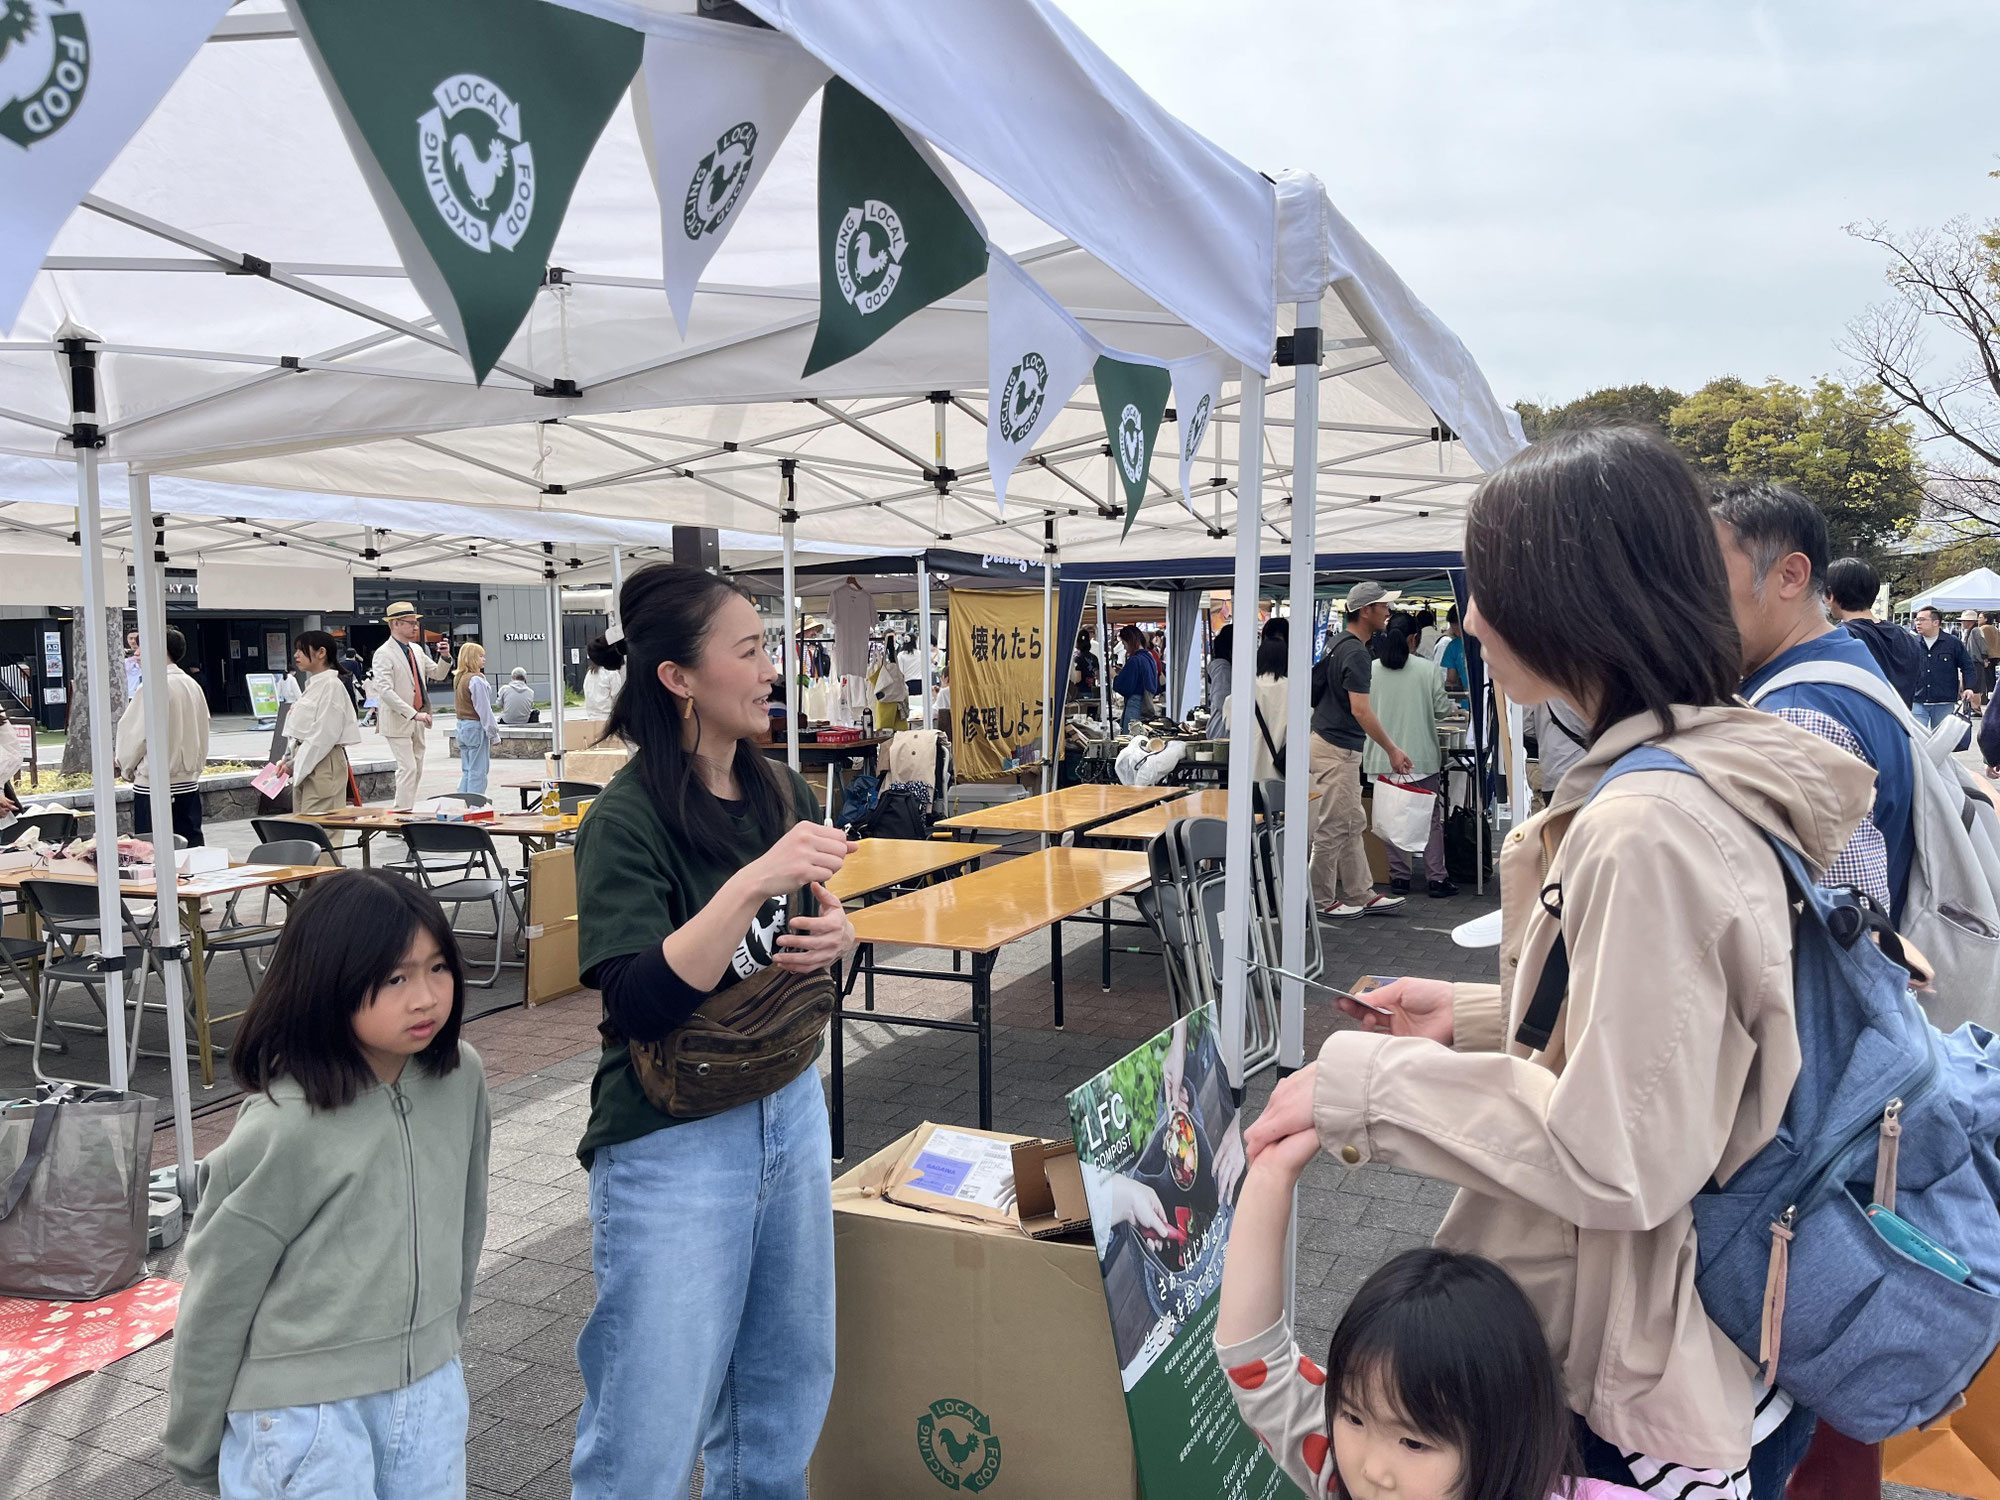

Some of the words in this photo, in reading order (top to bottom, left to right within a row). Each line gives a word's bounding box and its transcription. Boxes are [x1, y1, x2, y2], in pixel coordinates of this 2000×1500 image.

[23, 35, 87, 133] FOOD
[445, 82, 508, 126] LOCAL
[723, 125, 754, 149] LOCAL
[425, 131, 482, 243] CYCLING
[506, 163, 531, 236] FOOD
[686, 168, 707, 237] CYCLING
[716, 170, 748, 223] FOOD
[870, 204, 902, 249] LOCAL
[837, 216, 855, 295] CYCLING
[865, 274, 895, 309] FOOD
[1025, 355, 1045, 384] LOCAL
[1001, 374, 1017, 435] CYCLING
[982, 554, 1061, 573] patago
[47, 644, 59, 652] 入口
[505, 633, 546, 641] STARBUCKS
[971, 625, 1041, 662] 壊れたら
[1084, 1093, 1127, 1151] LFC
[1094, 1133, 1132, 1172] COMPOST
[936, 1402, 981, 1427] LOCAL
[920, 1425, 955, 1485] CYCLING
[975, 1447, 999, 1486] FOOD
